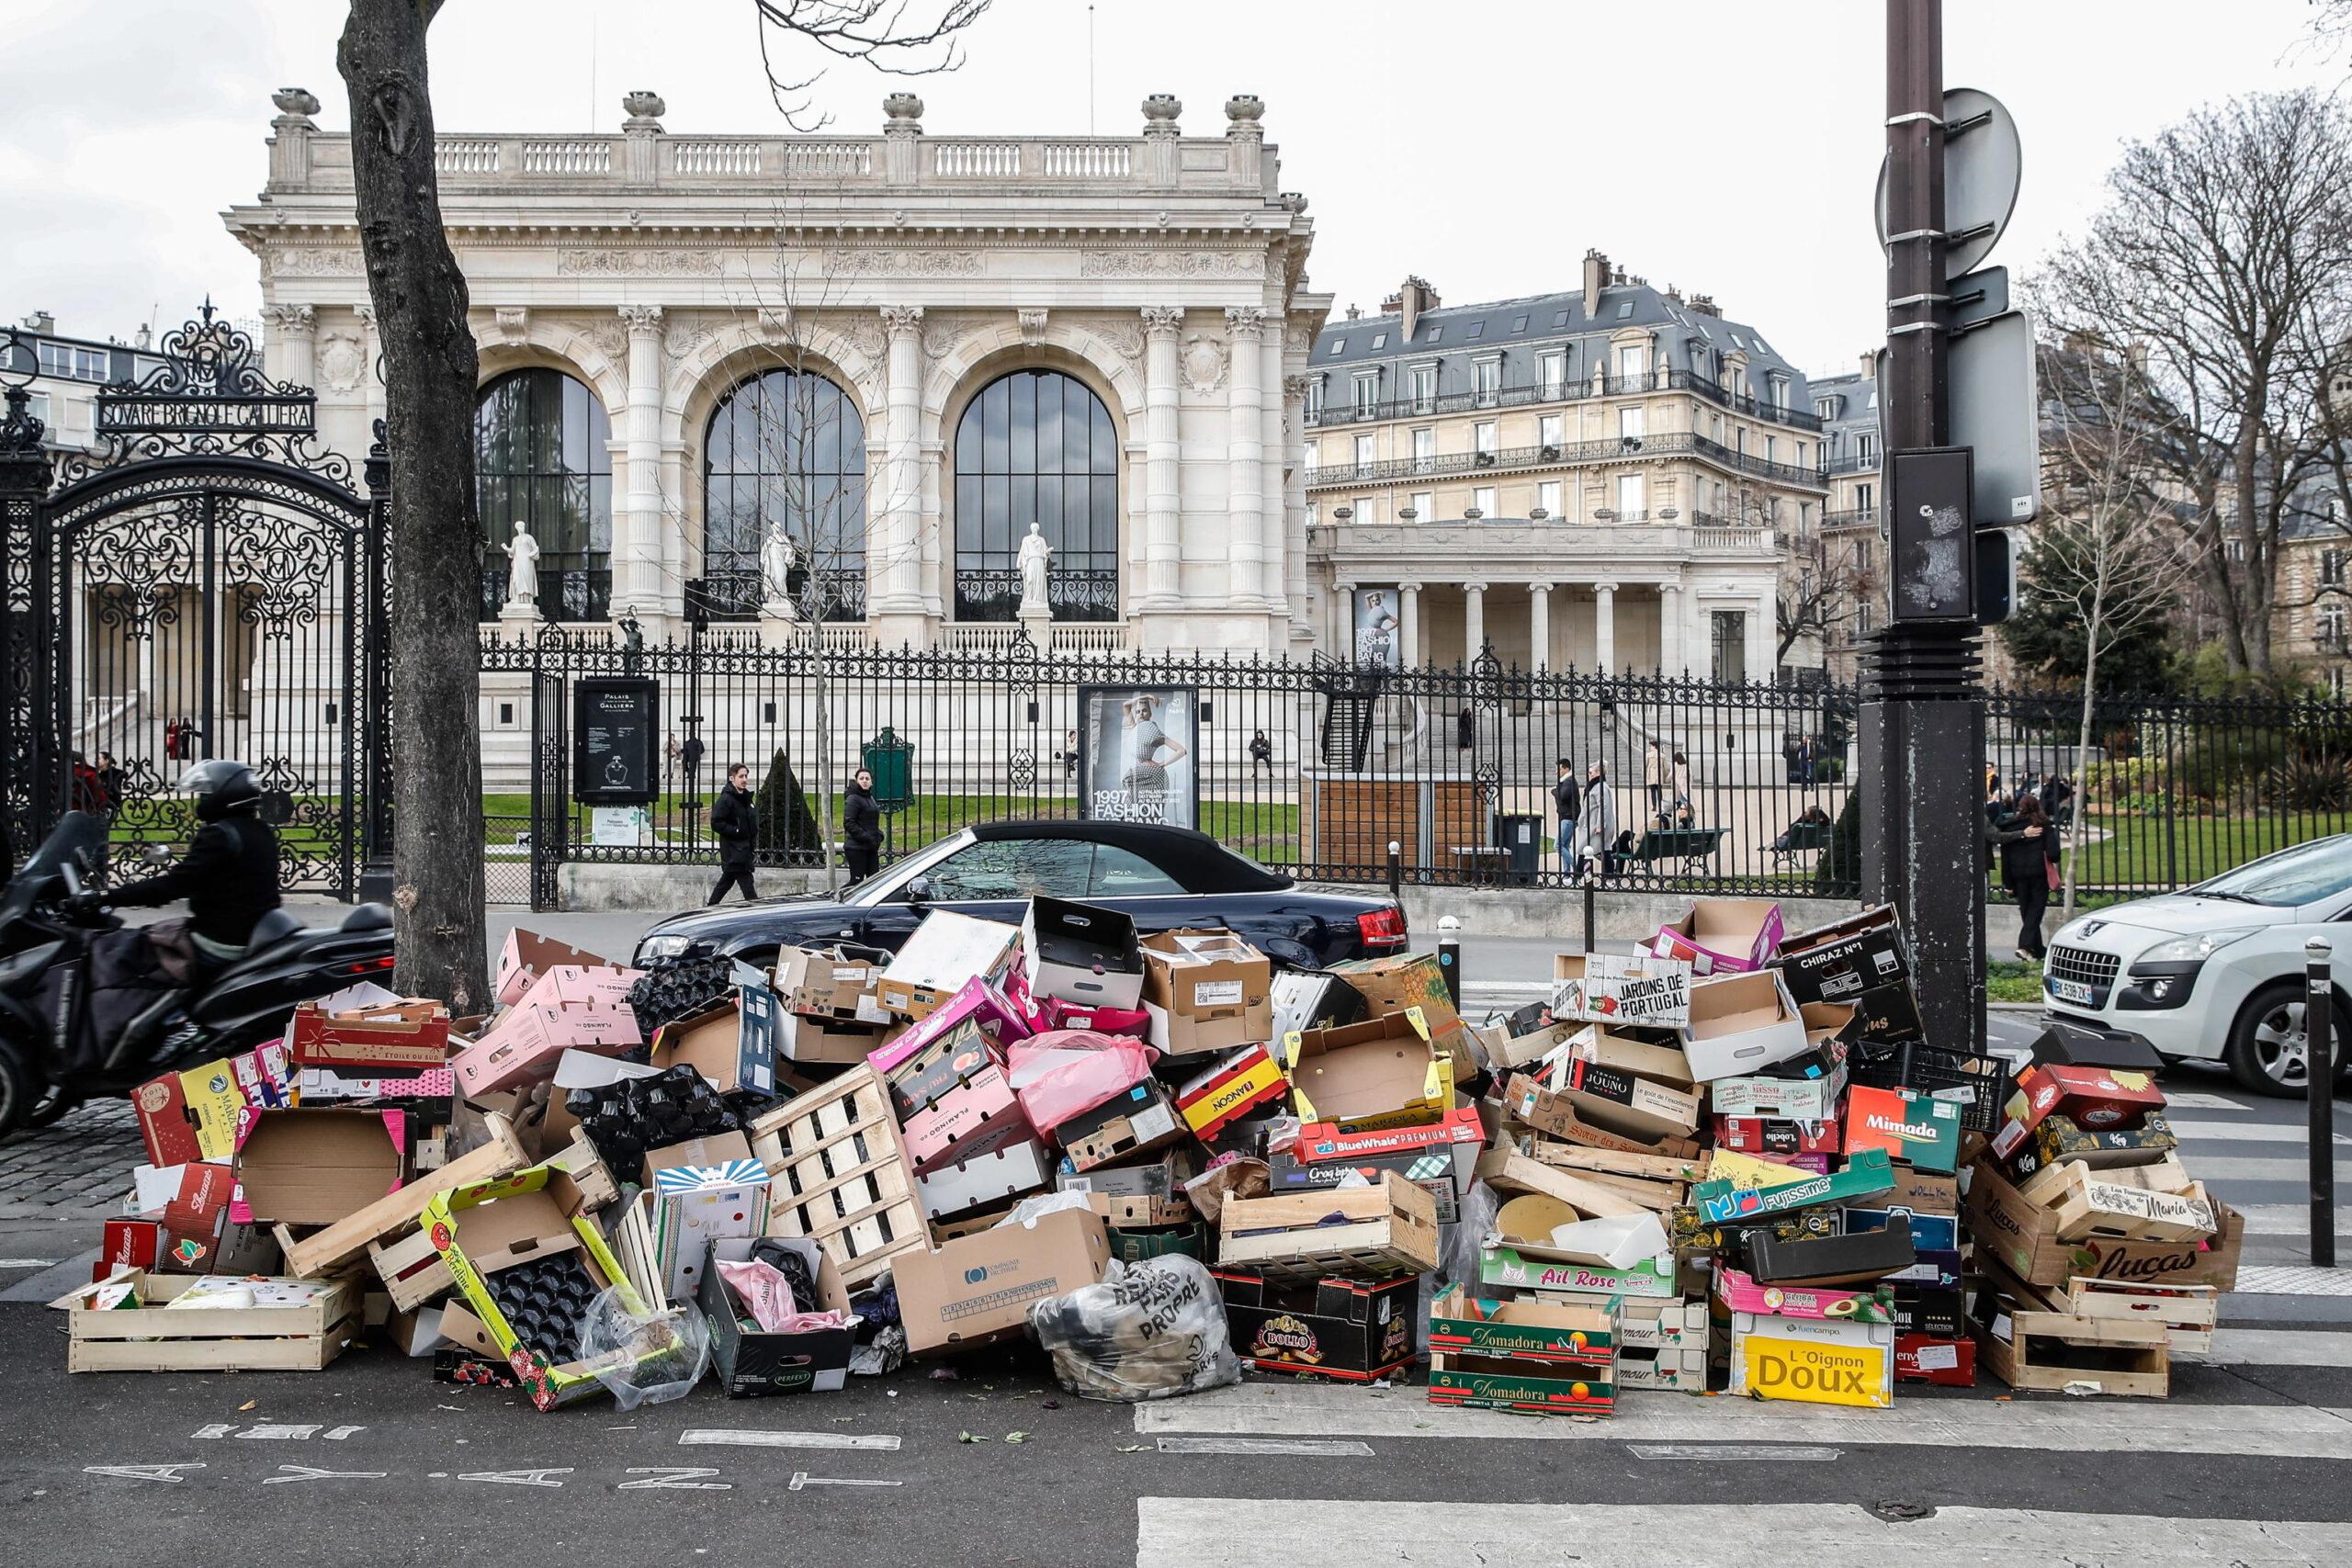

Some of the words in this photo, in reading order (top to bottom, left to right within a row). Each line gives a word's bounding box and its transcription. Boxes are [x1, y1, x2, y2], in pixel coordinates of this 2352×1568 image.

[1357, 644, 1373, 653] BIG
[1093, 790, 1128, 805] 1997
[1094, 803, 1163, 818] FASHION
[1800, 948, 1843, 969] CHIRAZ
[1619, 978, 1665, 1001] JARDINS
[1667, 974, 1684, 991] DE
[1620, 992, 1688, 1018] PORTUGAL
[930, 1107, 969, 1136] FLAMINGO
[1866, 1114, 1937, 1138] Mimada
[1400, 1130, 1447, 1145] PREMIUM
[1569, 1125, 1599, 1141] Saveur
[1600, 1134, 1614, 1147] des
[2146, 1196, 2187, 1219] Maria
[1540, 1269, 1568, 1287] Ail
[1574, 1270, 1617, 1288] Rose
[1138, 1273, 1201, 1341] PROPRE
[1785, 1292, 1817, 1302] GLOBAL
[1268, 1333, 1308, 1348] BOLLO
[1472, 1326, 1544, 1350] Domadora
[1798, 1325, 1841, 1336] fuencampo
[1758, 1355, 1866, 1395] Doux
[1473, 1379, 1545, 1402] Domadora
